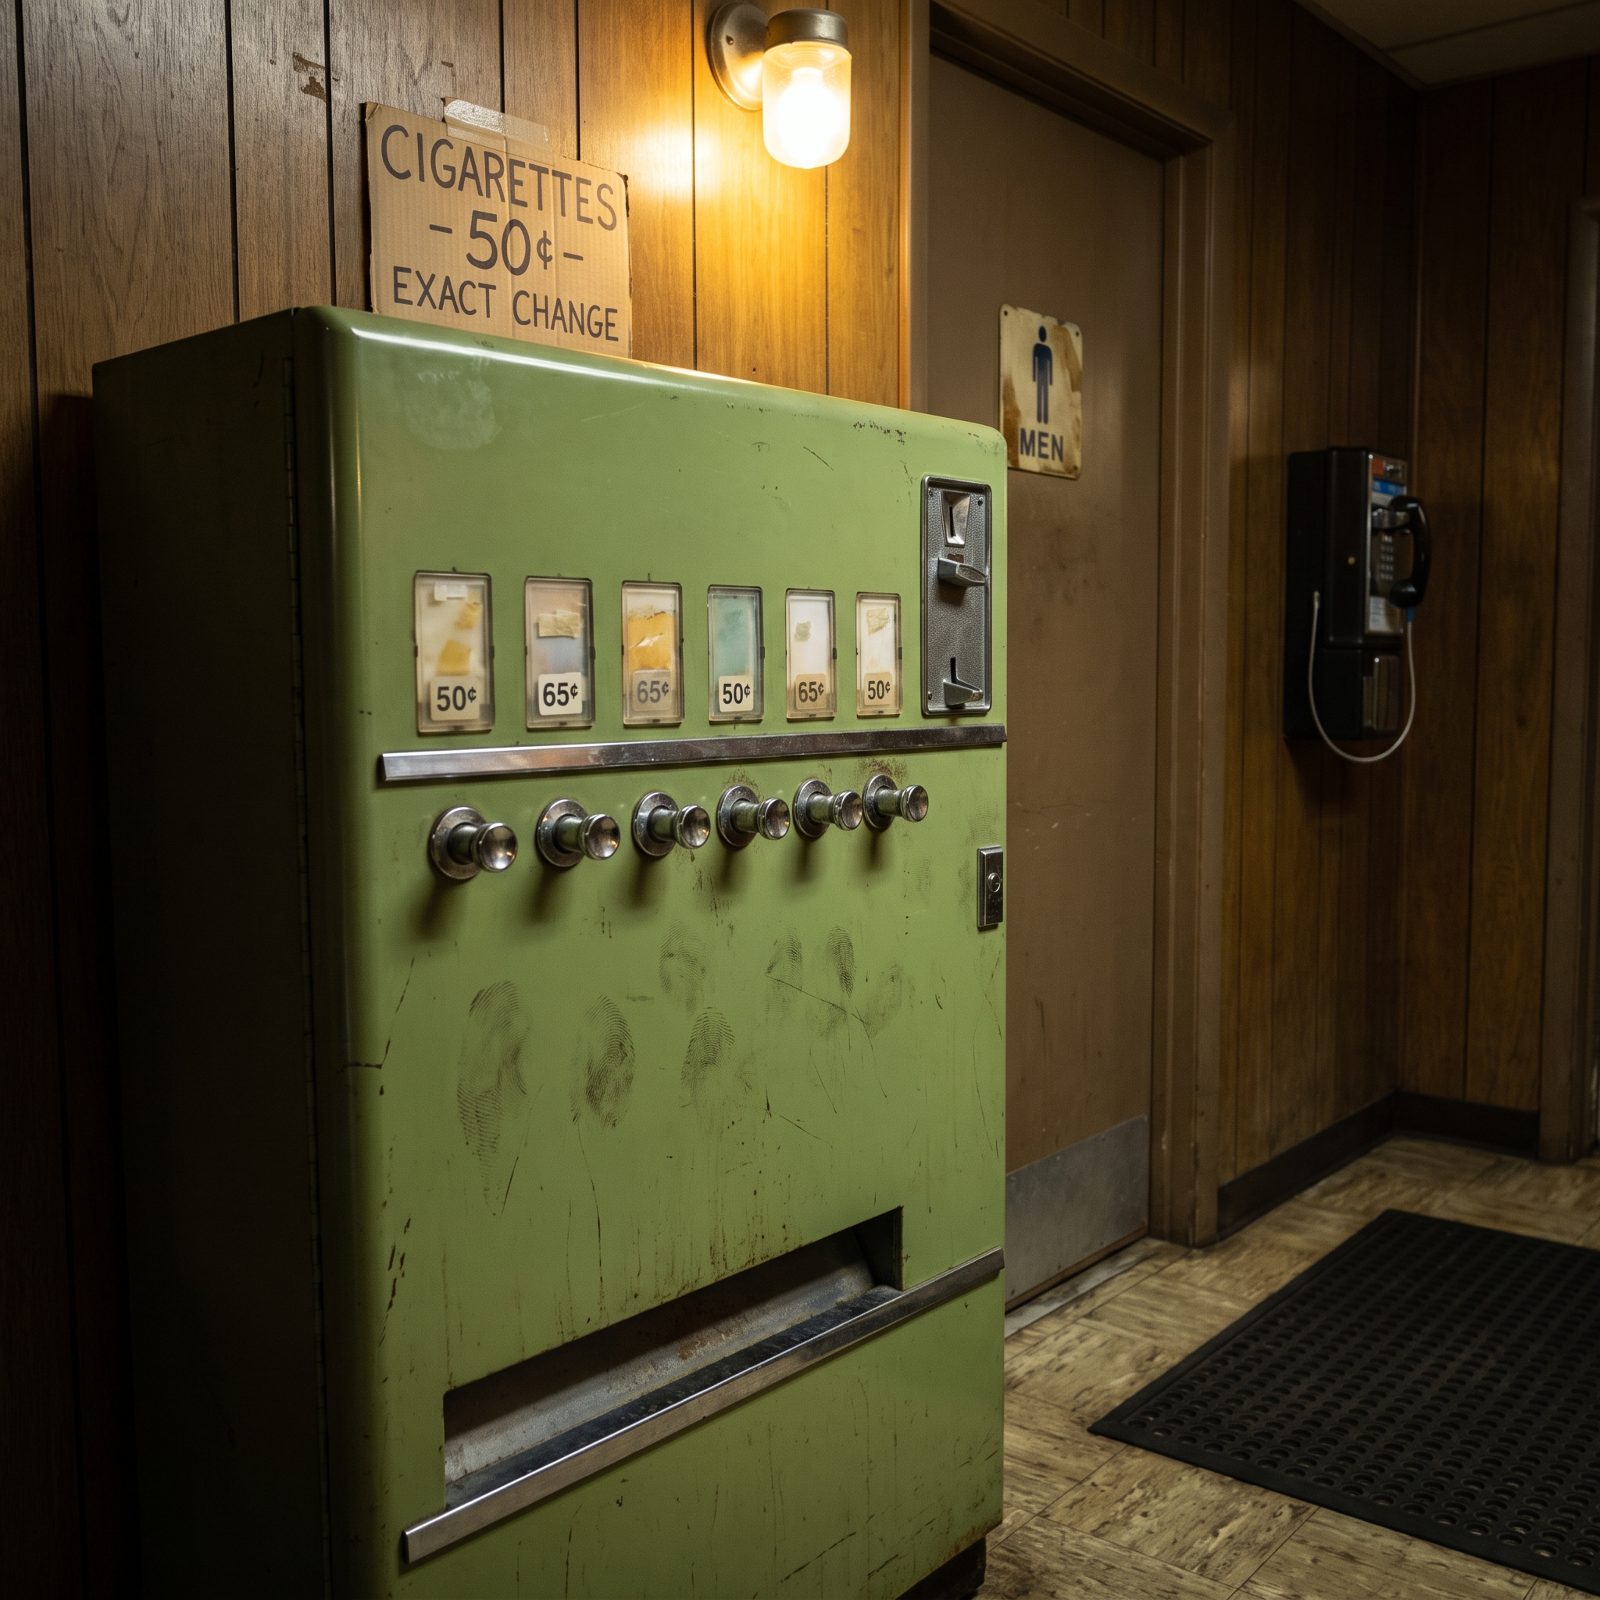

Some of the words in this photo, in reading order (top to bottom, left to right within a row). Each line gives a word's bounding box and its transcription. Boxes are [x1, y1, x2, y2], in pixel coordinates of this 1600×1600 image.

[380, 124, 617, 231] CIGARETTES
[393, 265, 497, 318] EXACT
[512, 290, 619, 342] CHANGE
[1020, 427, 1064, 463] MEN
[436, 685, 477, 711] 50¢
[542, 682, 579, 707] 65¢
[637, 680, 669, 704] 65¢
[722, 683, 751, 705] 50¢
[798, 681, 824, 703] 65¢
[867, 680, 891, 701] 50¢
